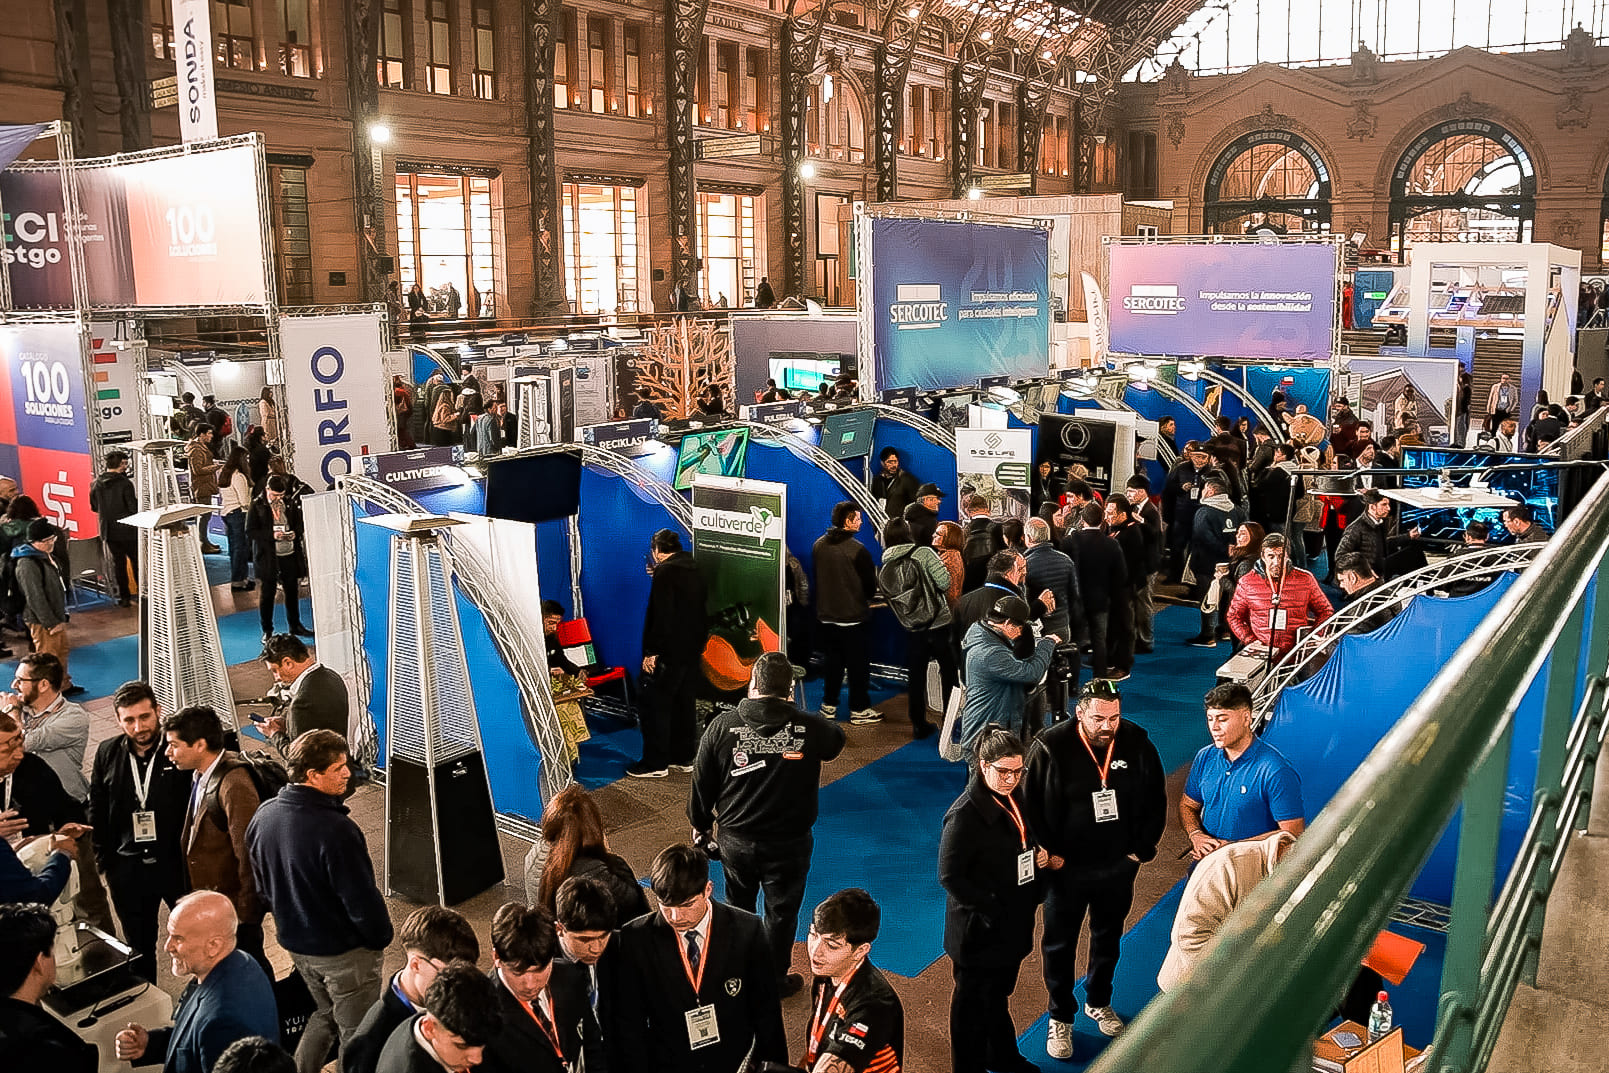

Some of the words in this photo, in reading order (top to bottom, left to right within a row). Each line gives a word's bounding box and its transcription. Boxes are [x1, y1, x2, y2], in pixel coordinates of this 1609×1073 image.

[183, 17, 201, 124] SONDA
[165, 206, 215, 244] 100
[0, 245, 61, 268] stgo
[1123, 297, 1186, 310] SERCOTEC
[1200, 290, 1249, 301] Impulsamos
[1250, 292, 1258, 300] la
[1260, 291, 1312, 301] innovación
[890, 302, 949, 323] SERCOTEC
[1210, 302, 1236, 311] desde
[1238, 303, 1245, 311] la
[1247, 303, 1312, 312] sostenibilidad
[21, 360, 70, 404] 100
[24, 401, 74, 418] SOLUCIONES
[701, 511, 763, 534] cultiverde
